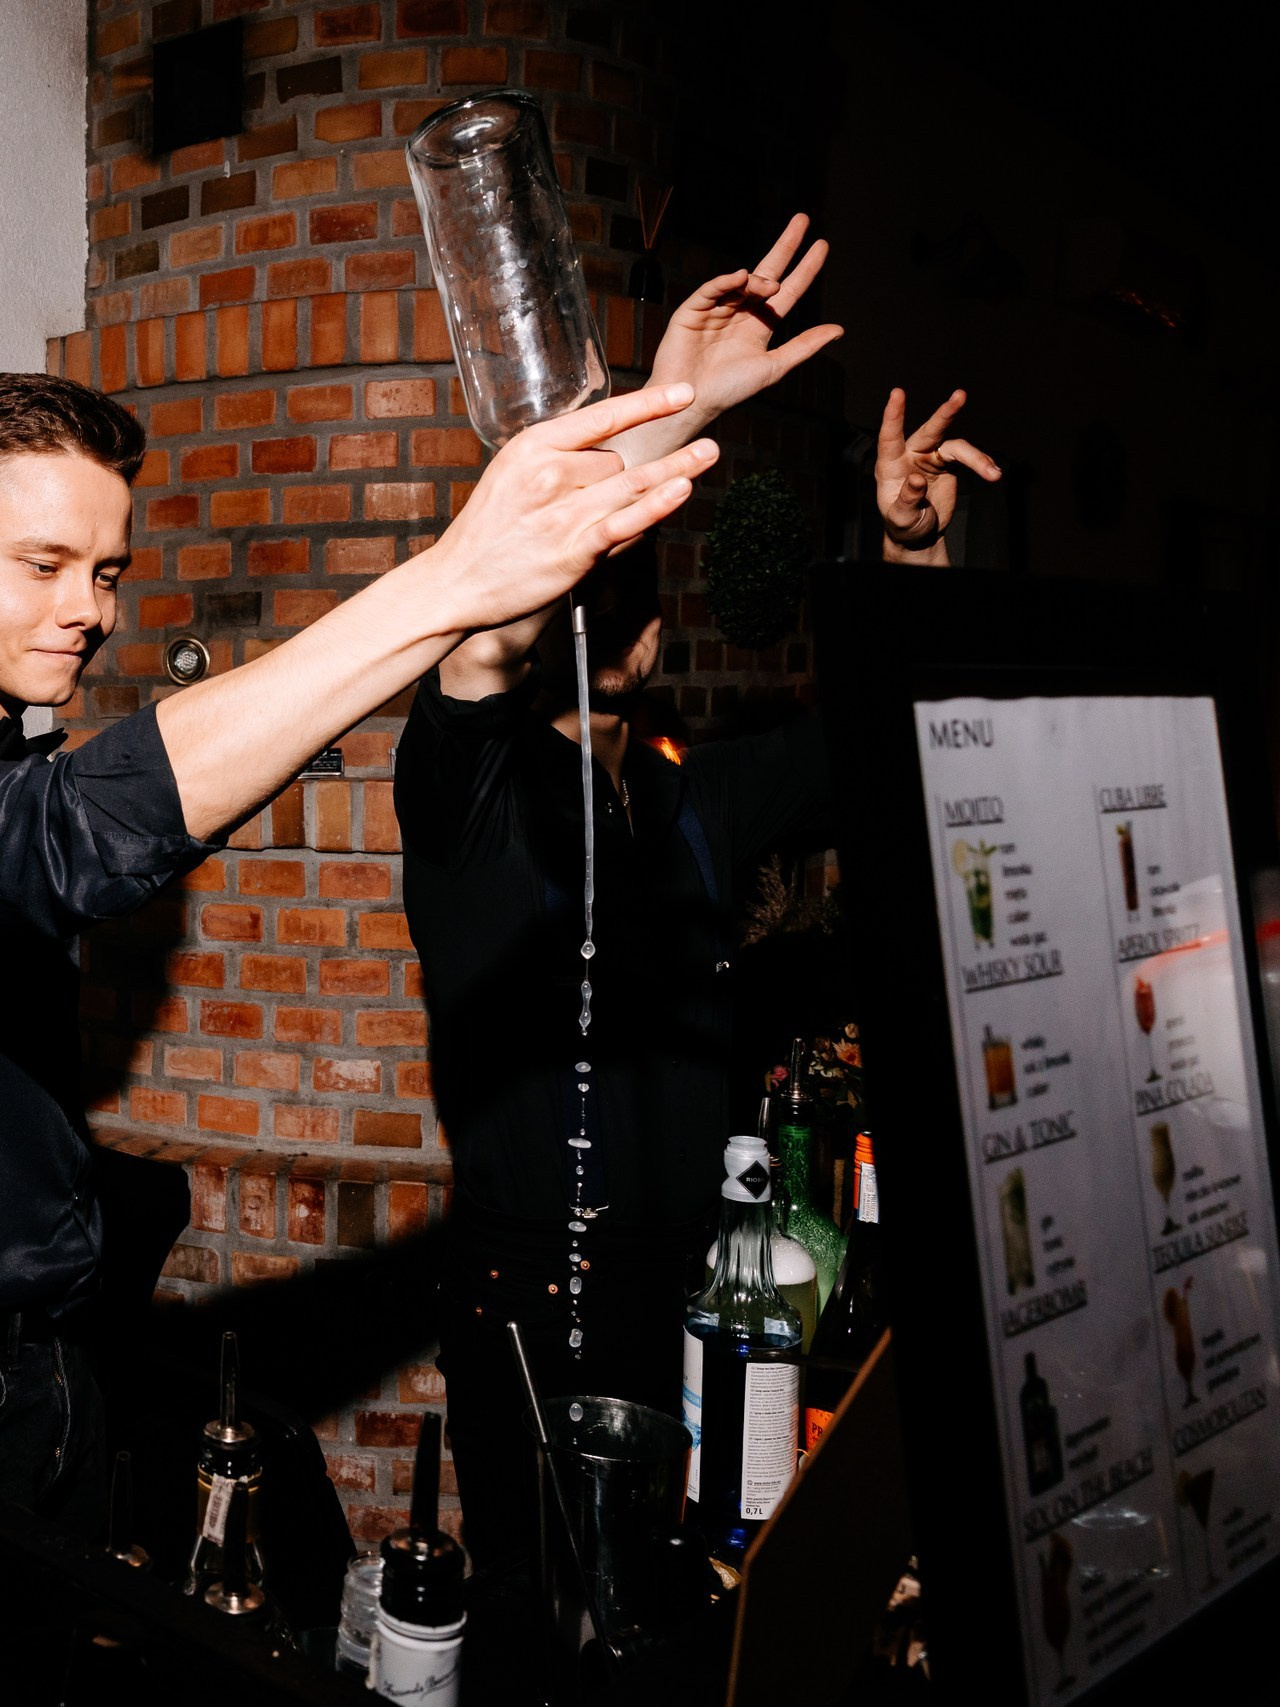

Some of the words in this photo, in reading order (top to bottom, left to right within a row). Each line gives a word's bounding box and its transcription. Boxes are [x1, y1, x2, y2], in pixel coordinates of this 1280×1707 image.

[929, 719, 995, 749] MENU
[944, 796, 1004, 823] MOJITO
[1099, 787, 1134, 809] CUBA
[1136, 784, 1166, 807] LIBRE
